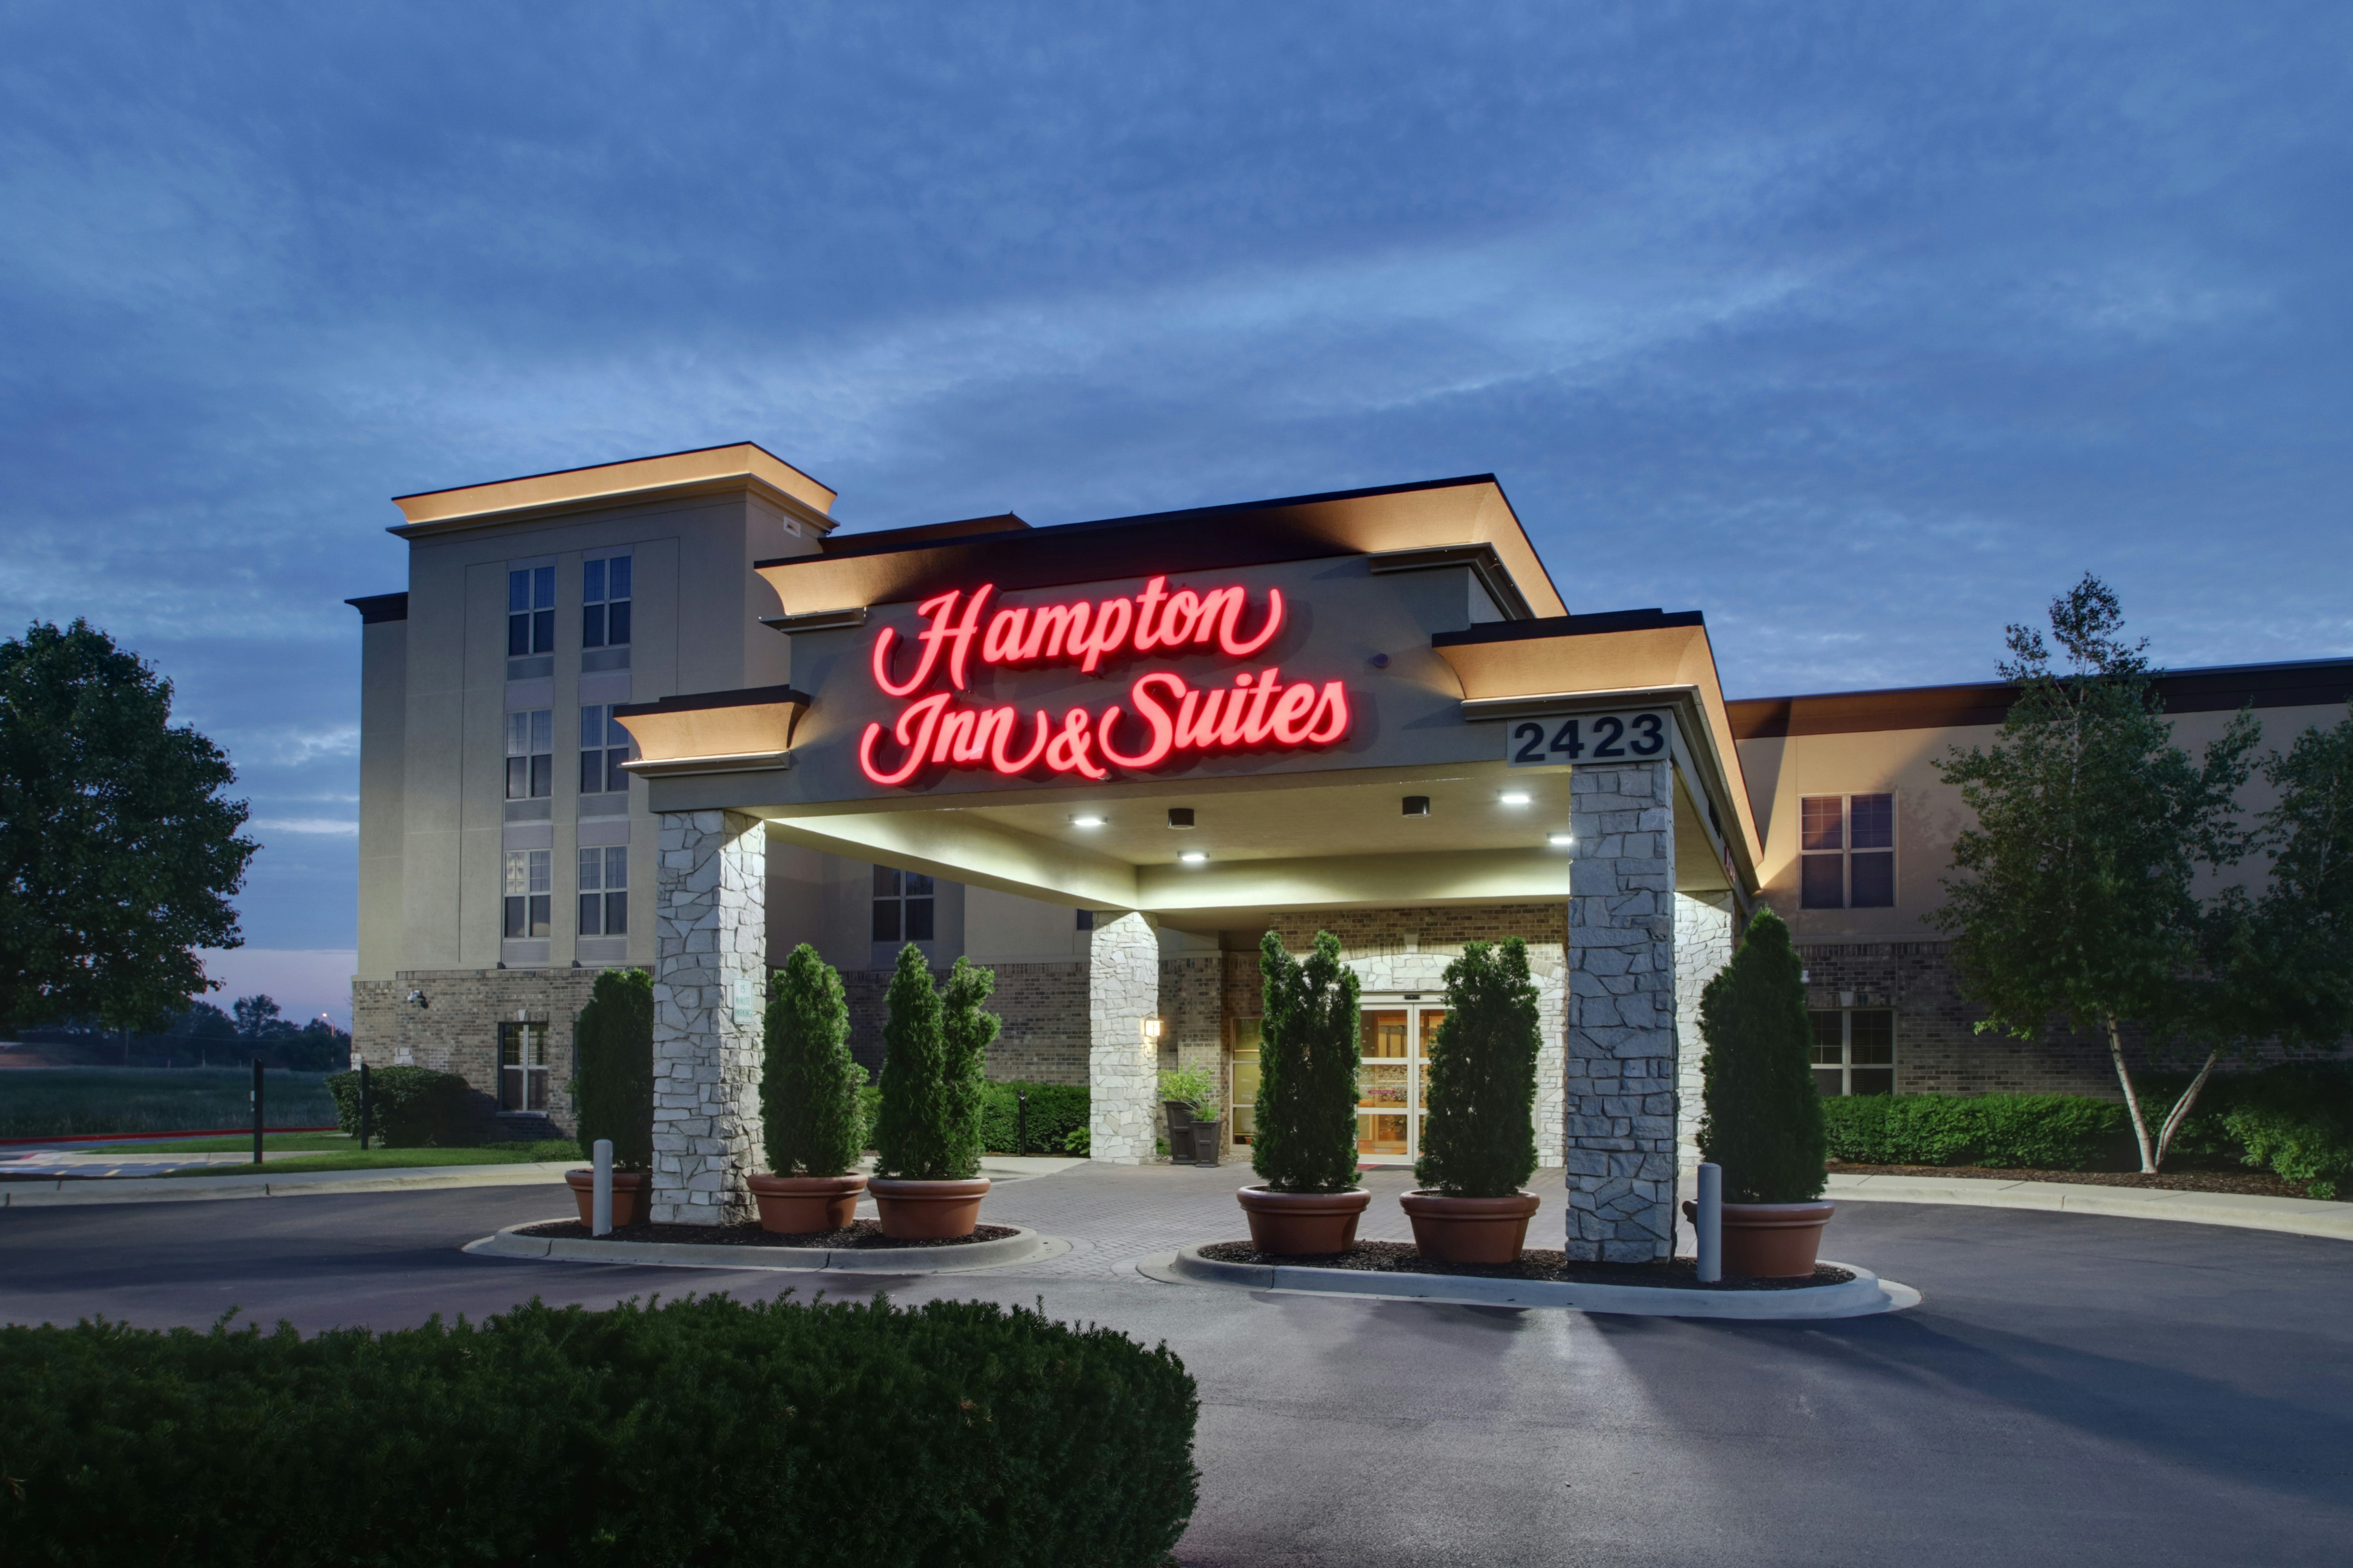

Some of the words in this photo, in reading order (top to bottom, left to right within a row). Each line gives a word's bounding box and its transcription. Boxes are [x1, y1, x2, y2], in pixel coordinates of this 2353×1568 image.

[873, 576, 1282, 696] Hampton
[860, 693, 1049, 784] Inn
[1045, 708, 1106, 779] &
[1098, 668, 1348, 767] Suites
[1515, 713, 1664, 763] 2423
[736, 997, 750, 1006] MINUTE
[740, 985, 746, 993] 15
[735, 1008, 752, 1018] PARKING
